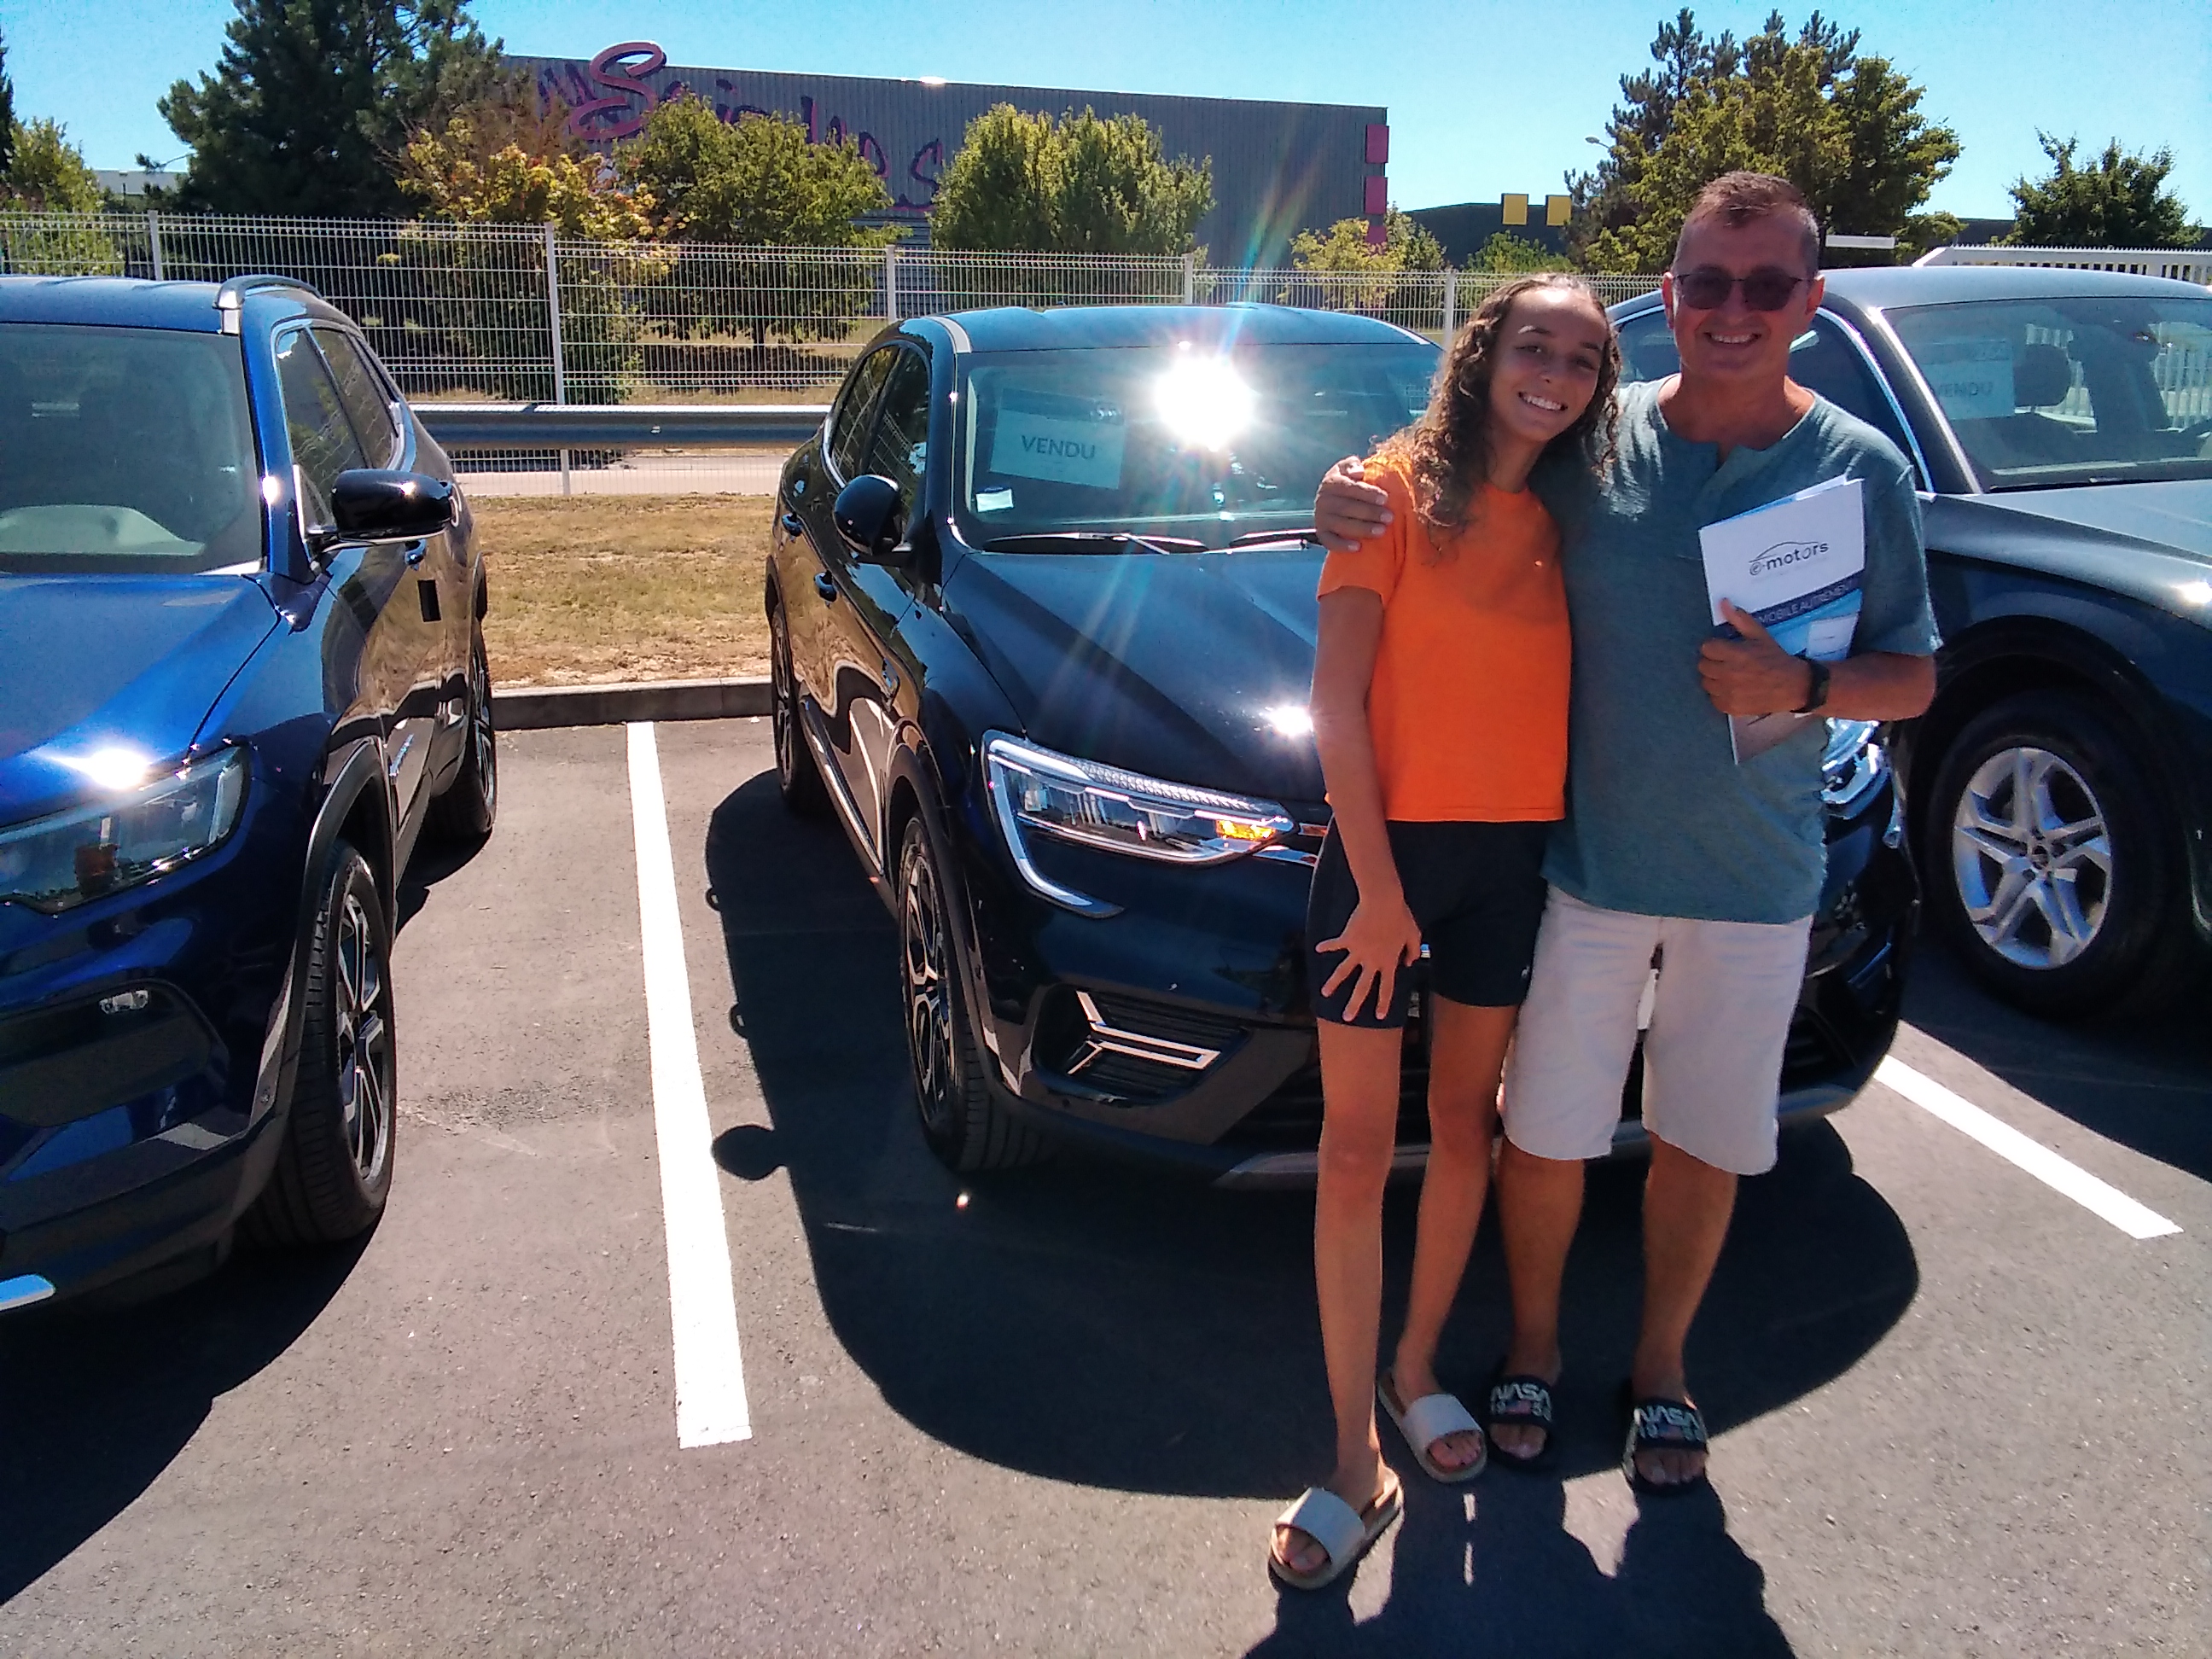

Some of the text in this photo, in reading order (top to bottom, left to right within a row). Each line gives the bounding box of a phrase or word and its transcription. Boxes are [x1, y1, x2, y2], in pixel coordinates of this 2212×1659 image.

[1021, 435, 1096, 459] VENDU
[1490, 1382, 1552, 1410] NASA
[1633, 1406, 1699, 1429] NASA
